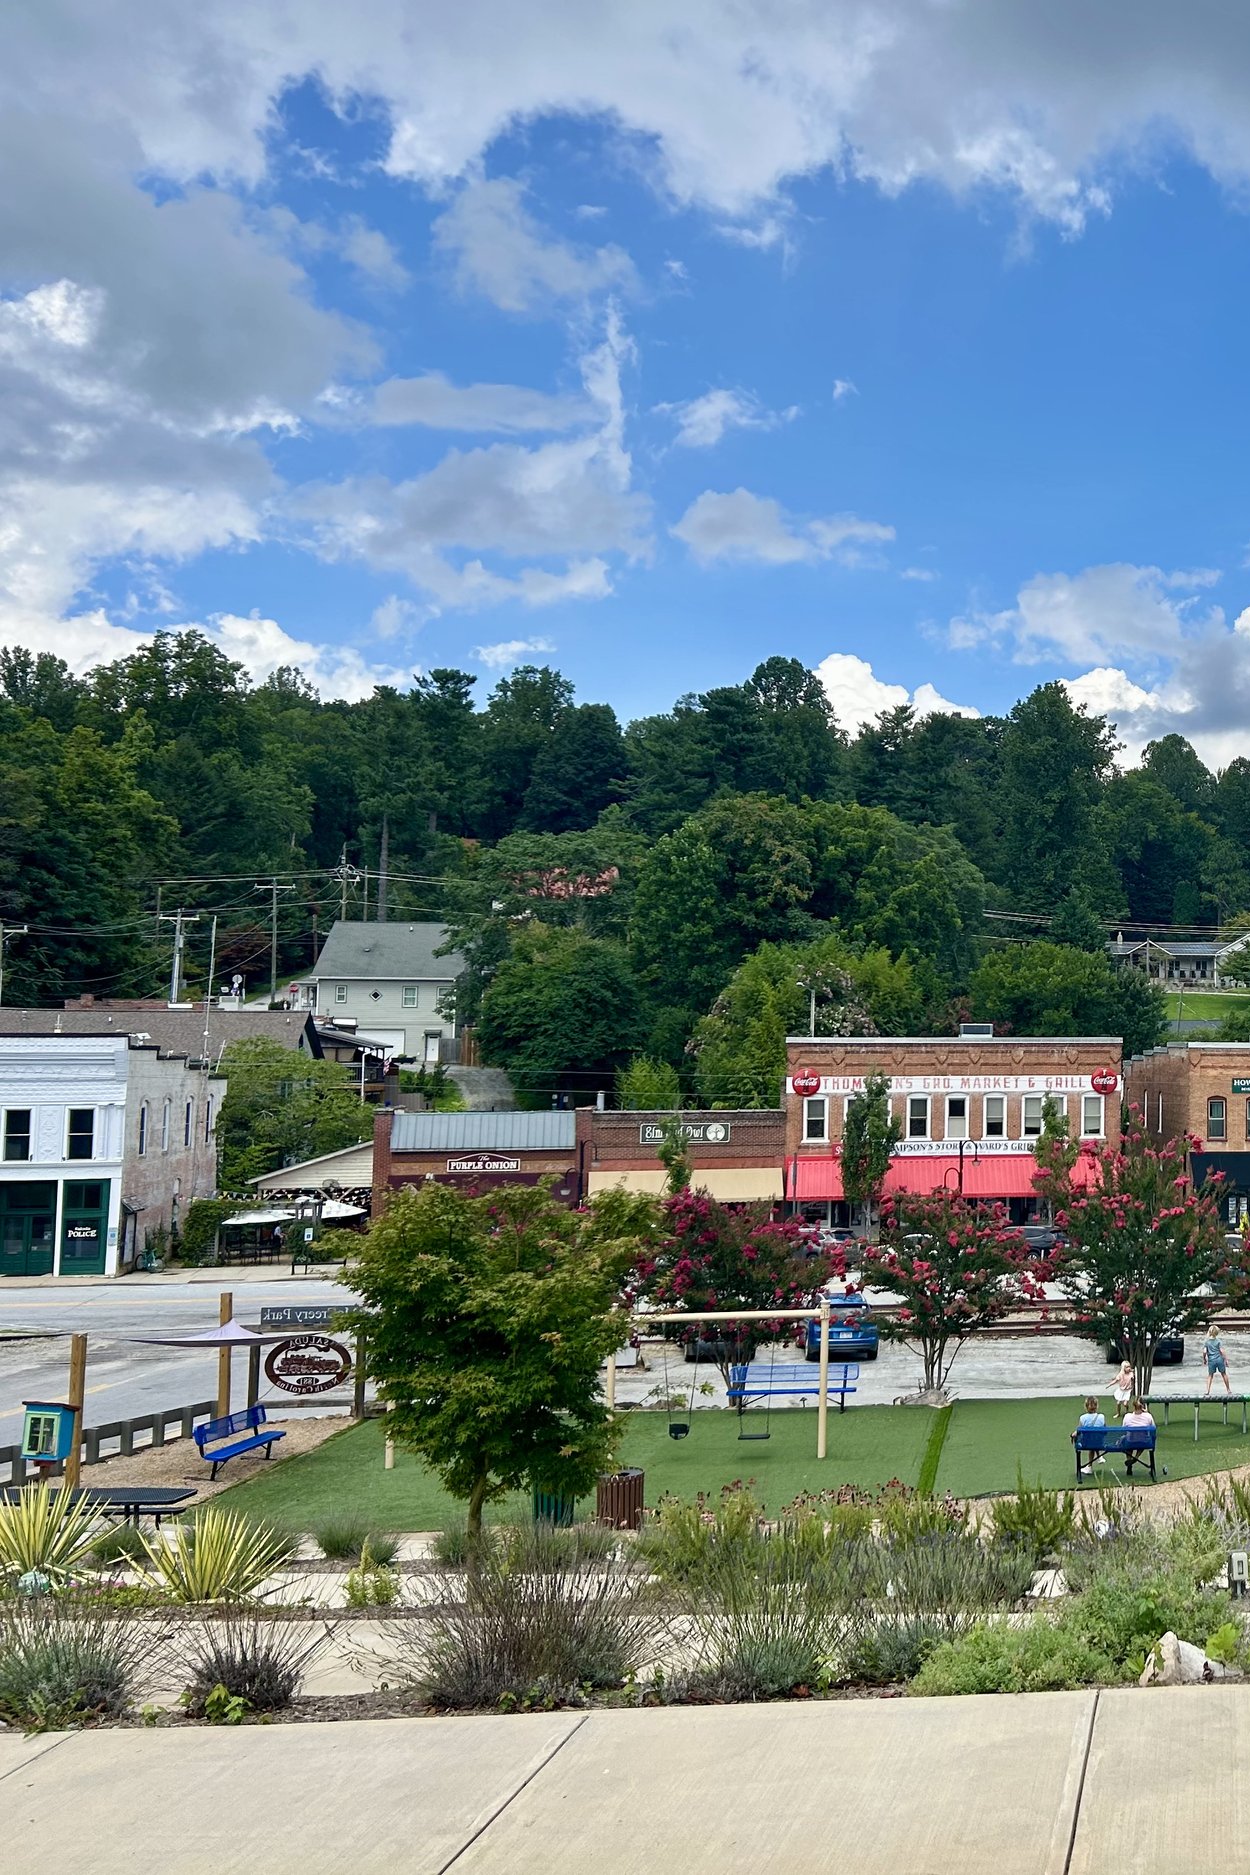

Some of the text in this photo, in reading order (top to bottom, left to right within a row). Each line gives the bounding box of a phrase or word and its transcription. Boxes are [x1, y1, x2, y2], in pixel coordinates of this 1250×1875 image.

[823, 1077, 1086, 1090] THOMN'S GRO. MARKET & GRILL
[895, 1143, 933, 1152] MPSON'S
[935, 1142, 960, 1151] STOR
[450, 1161, 517, 1170] PURPLE ONION
[67, 1230, 97, 1238] POLICE
